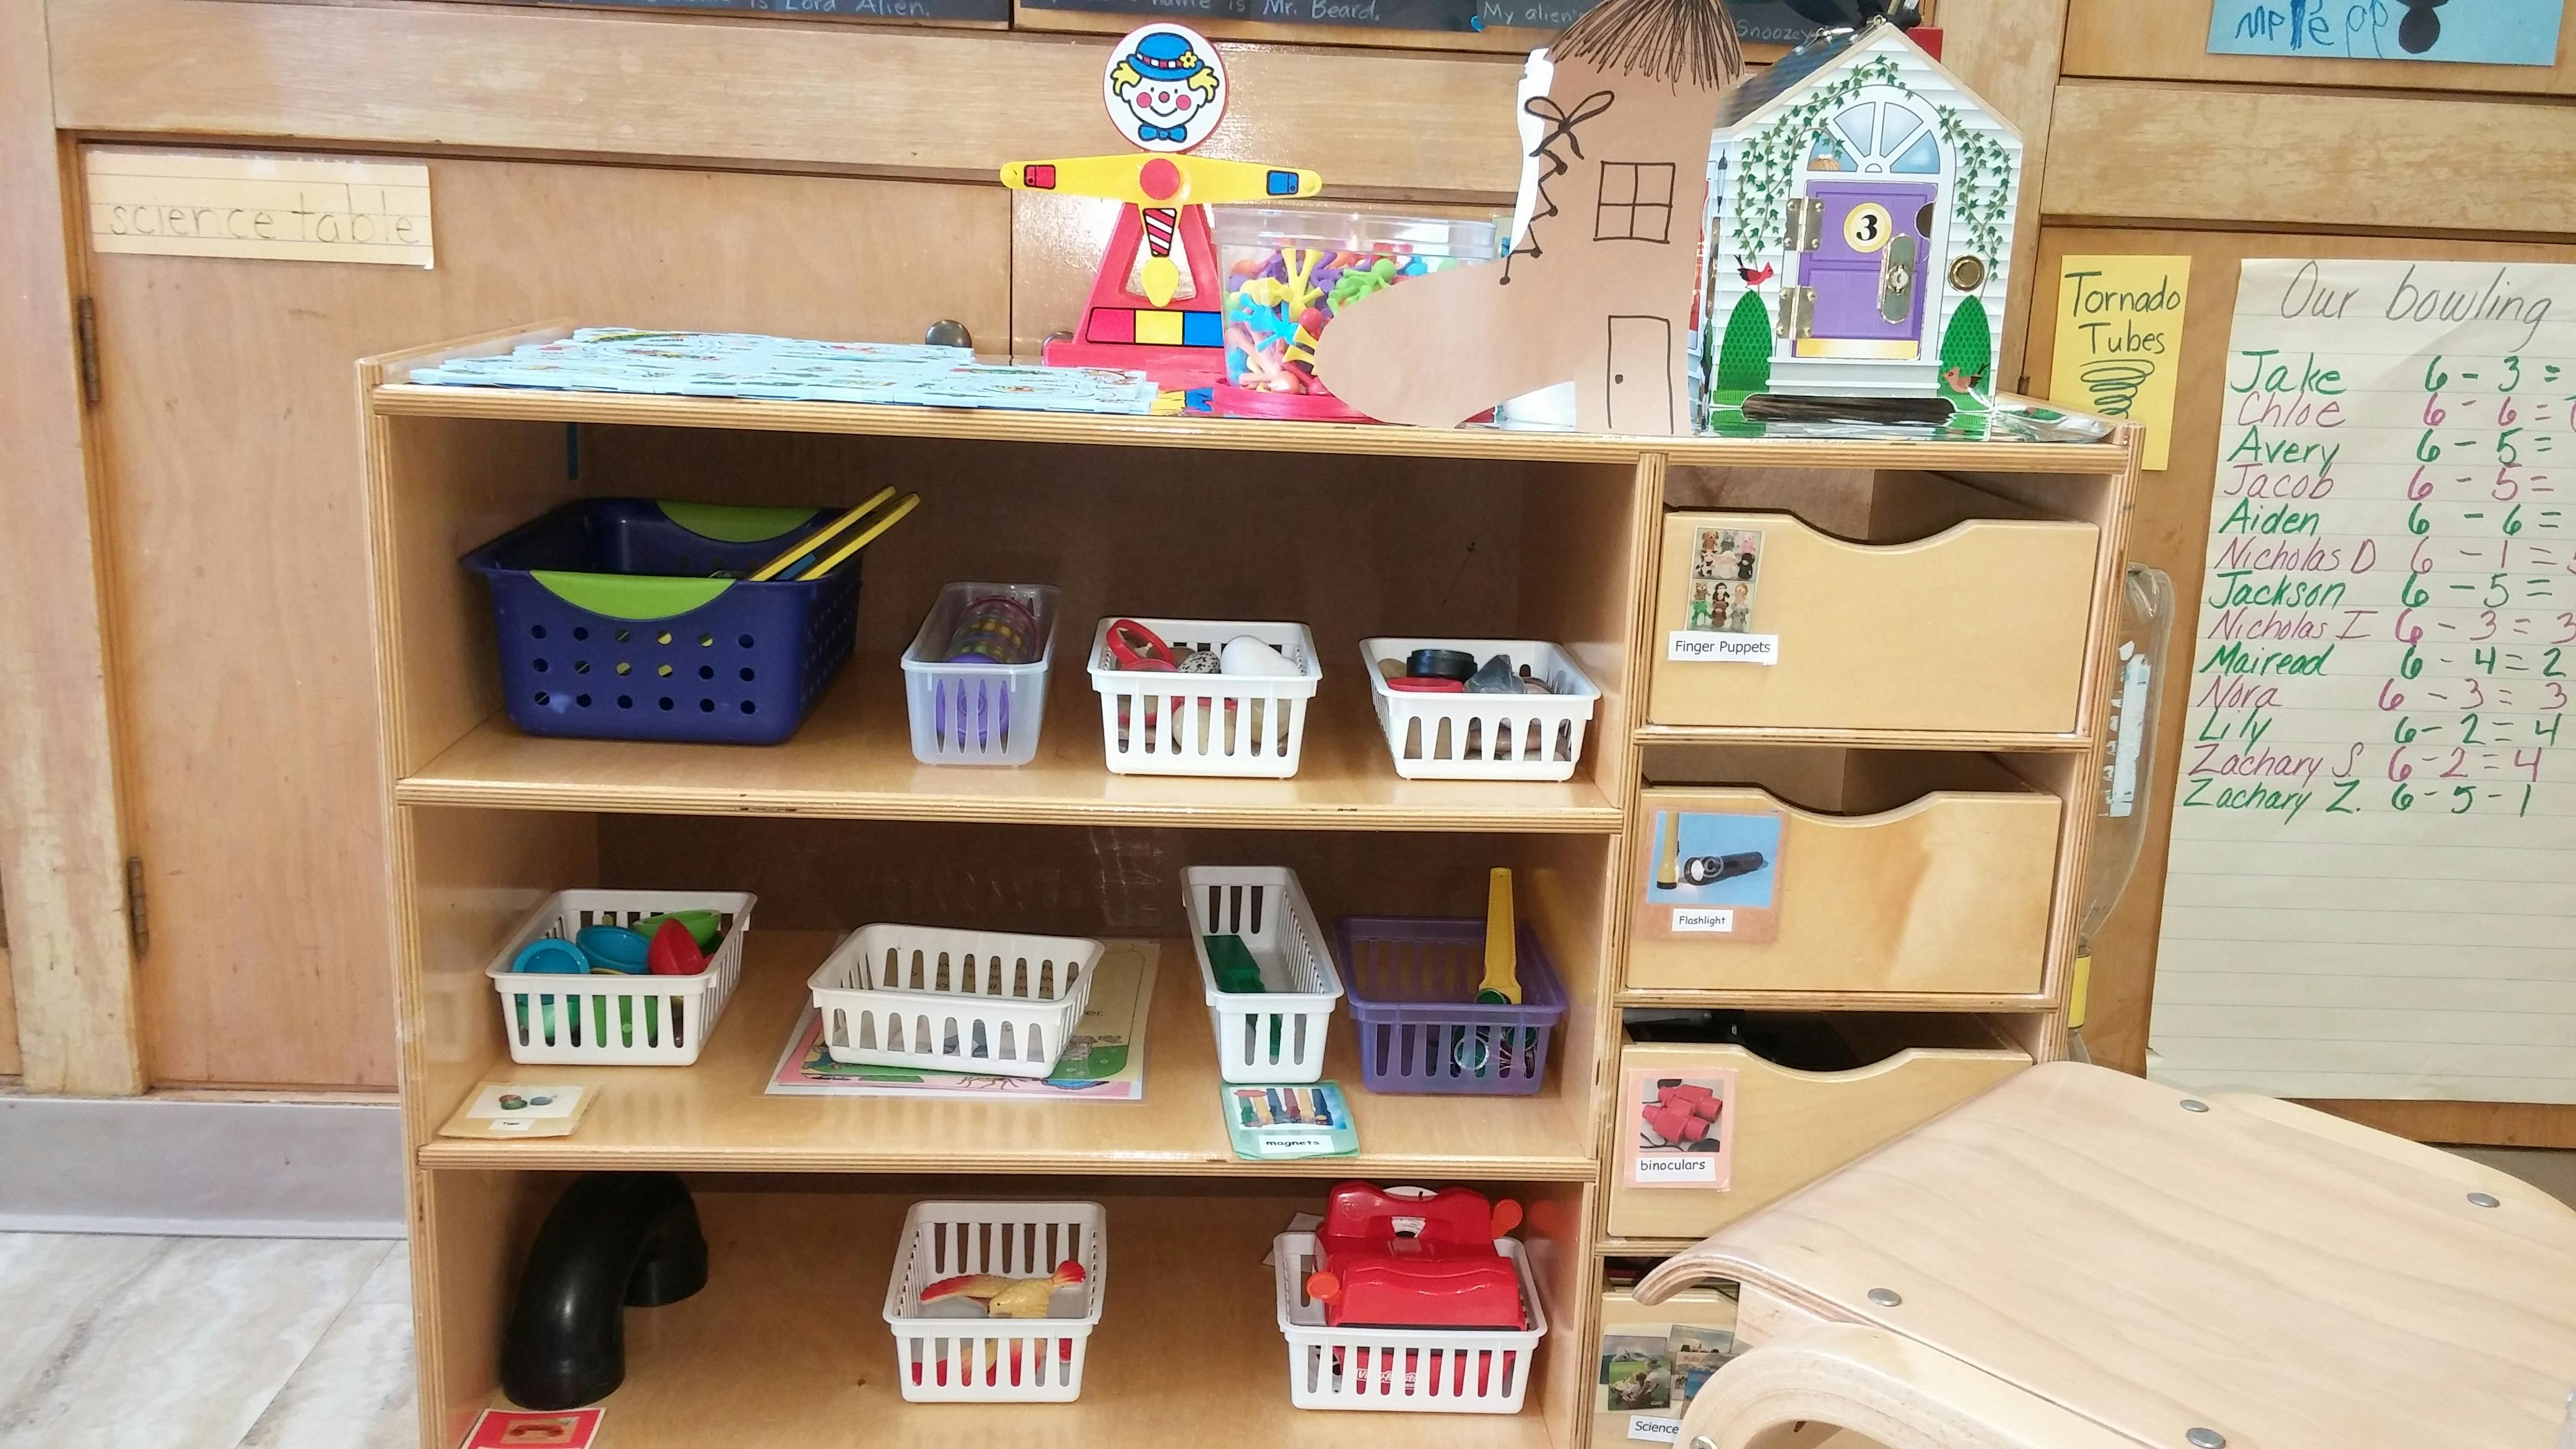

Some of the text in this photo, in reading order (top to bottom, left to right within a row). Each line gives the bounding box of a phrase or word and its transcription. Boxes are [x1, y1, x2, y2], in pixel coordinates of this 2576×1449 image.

[786, 0, 836, 12] Lord
[1263, 0, 1297, 15] Mr.
[1312, 0, 1379, 20] Beard.
[1484, 1, 1583, 25] My alien'
[111, 183, 419, 243] science table
[1856, 214, 1878, 241] 3
[2064, 271, 2181, 318] Tornado
[2281, 260, 2552, 352] Our bowling
[2078, 318, 2165, 355] Tubes
[2230, 350, 2347, 394] Jake
[2425, 355, 2448, 392] 6
[2498, 356, 2520, 392] 3
[2238, 389, 2346, 427] Chloe
[2423, 392, 2446, 426] 6
[2497, 396, 2517, 426] 6
[2227, 425, 2339, 476] Avery
[2416, 429, 2440, 463] 6
[2497, 427, 2523, 464] 5
[2224, 463, 2334, 499] Jacob
[2408, 465, 2434, 501] 6
[2491, 463, 2522, 501] 5
[2219, 497, 2320, 537] Aiden
[2408, 502, 2430, 534] 6
[2502, 503, 2522, 536] 6
[2214, 536, 2341, 572] Nicholas
[2351, 538, 2376, 574] D
[2411, 536, 2433, 574] 6
[2501, 539, 2508, 568] 1
[2208, 570, 2346, 610] Jackson
[2401, 572, 2429, 607] 6
[2483, 573, 2509, 607] 5
[2208, 606, 2328, 640] Nicholas
[2395, 607, 2424, 646] 6
[2469, 609, 2497, 641] 3
[2550, 612, 2576, 644] 3
[1676, 640, 1771, 655] Finger Puppets
[2199, 641, 2335, 677] Mairead
[2400, 645, 2423, 680] 6
[2475, 646, 2496, 674] 4
[2543, 647, 2567, 677] 2
[2197, 674, 2283, 708] Nora
[2378, 678, 2404, 711] 6
[2460, 678, 2484, 710] 3
[2539, 682, 2567, 710] 3
[2199, 706, 2273, 757] Lily
[2394, 716, 2417, 743] 6
[2460, 713, 2486, 745] 2
[2535, 713, 2562, 747] 4
[2188, 743, 2323, 788] Zachary
[2388, 746, 2412, 782] 6
[2439, 747, 2468, 778] 2
[2514, 747, 2542, 782] 4
[2183, 778, 2312, 824] Zachary
[2326, 779, 2361, 814] Z.
[2391, 783, 2414, 811] 6
[2451, 786, 2477, 814] 5
[2520, 783, 2531, 818] 1
[1679, 916, 1726, 927] Flashlight
[1640, 1159, 1705, 1171] binoculars
[1634, 1421, 1679, 1435] Science
